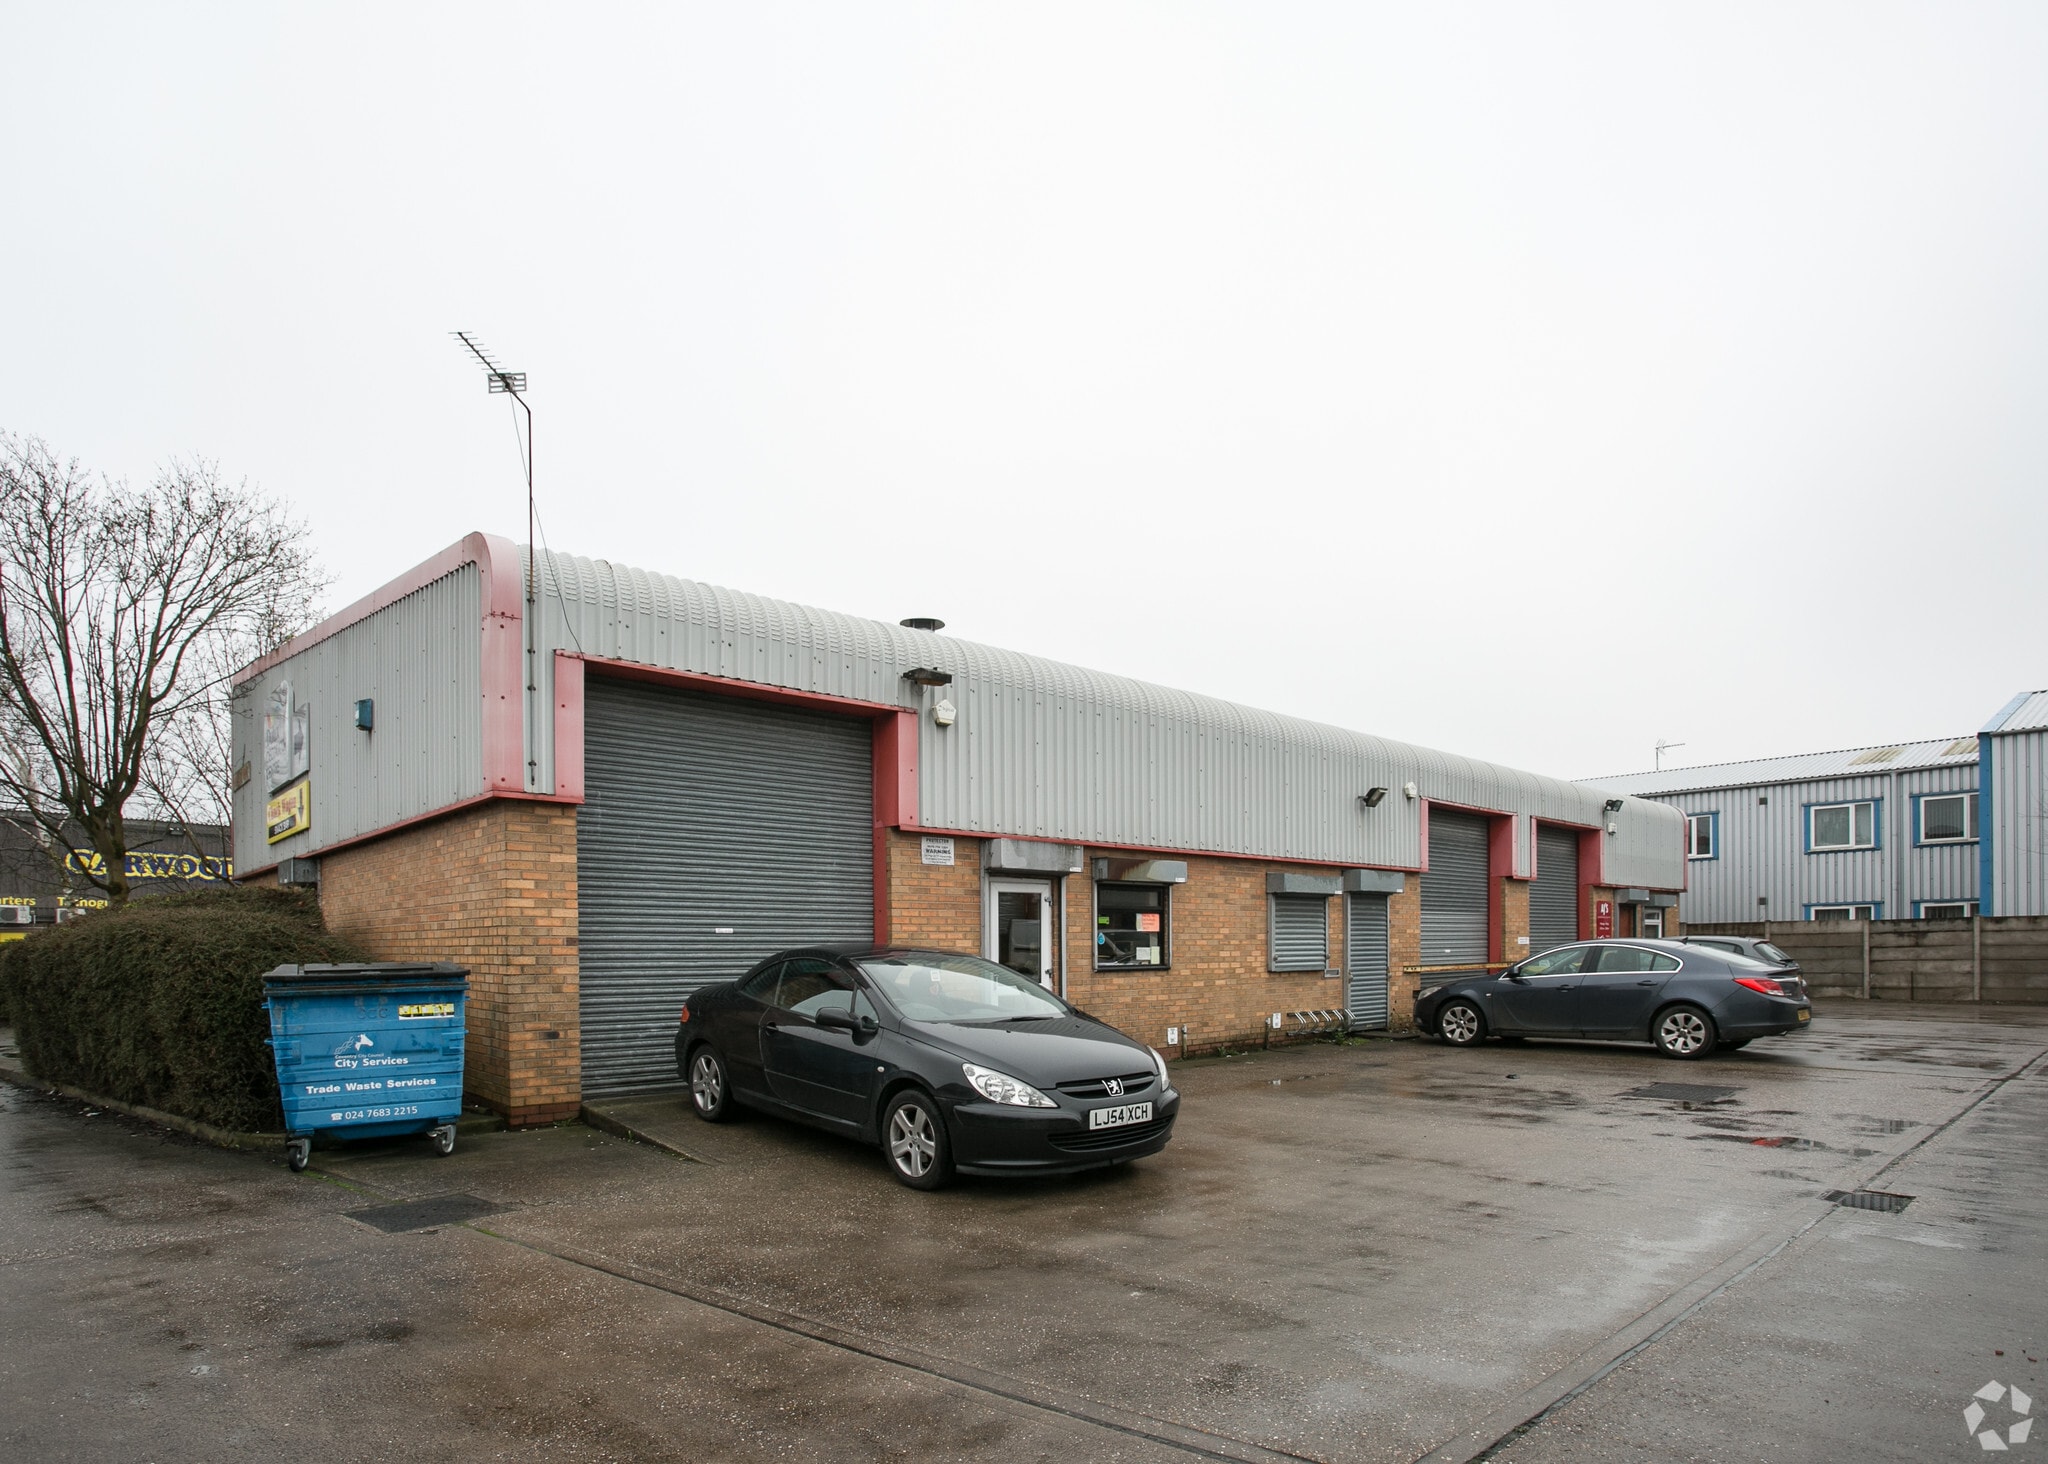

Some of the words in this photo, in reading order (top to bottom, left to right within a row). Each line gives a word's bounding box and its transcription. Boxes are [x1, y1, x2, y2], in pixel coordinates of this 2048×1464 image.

[0, 896, 36, 906] rters
[335, 1059, 358, 1069] City
[362, 1056, 409, 1067] Services
[306, 1084, 341, 1095] Trade
[345, 1081, 382, 1091] Waste
[387, 1077, 437, 1089] Services
[345, 1110, 364, 1120] 024
[367, 1108, 391, 1119] 7683
[394, 1106, 418, 1116] 2215
[1094, 1108, 1125, 1127] LJ54
[1128, 1104, 1148, 1121] XCH
